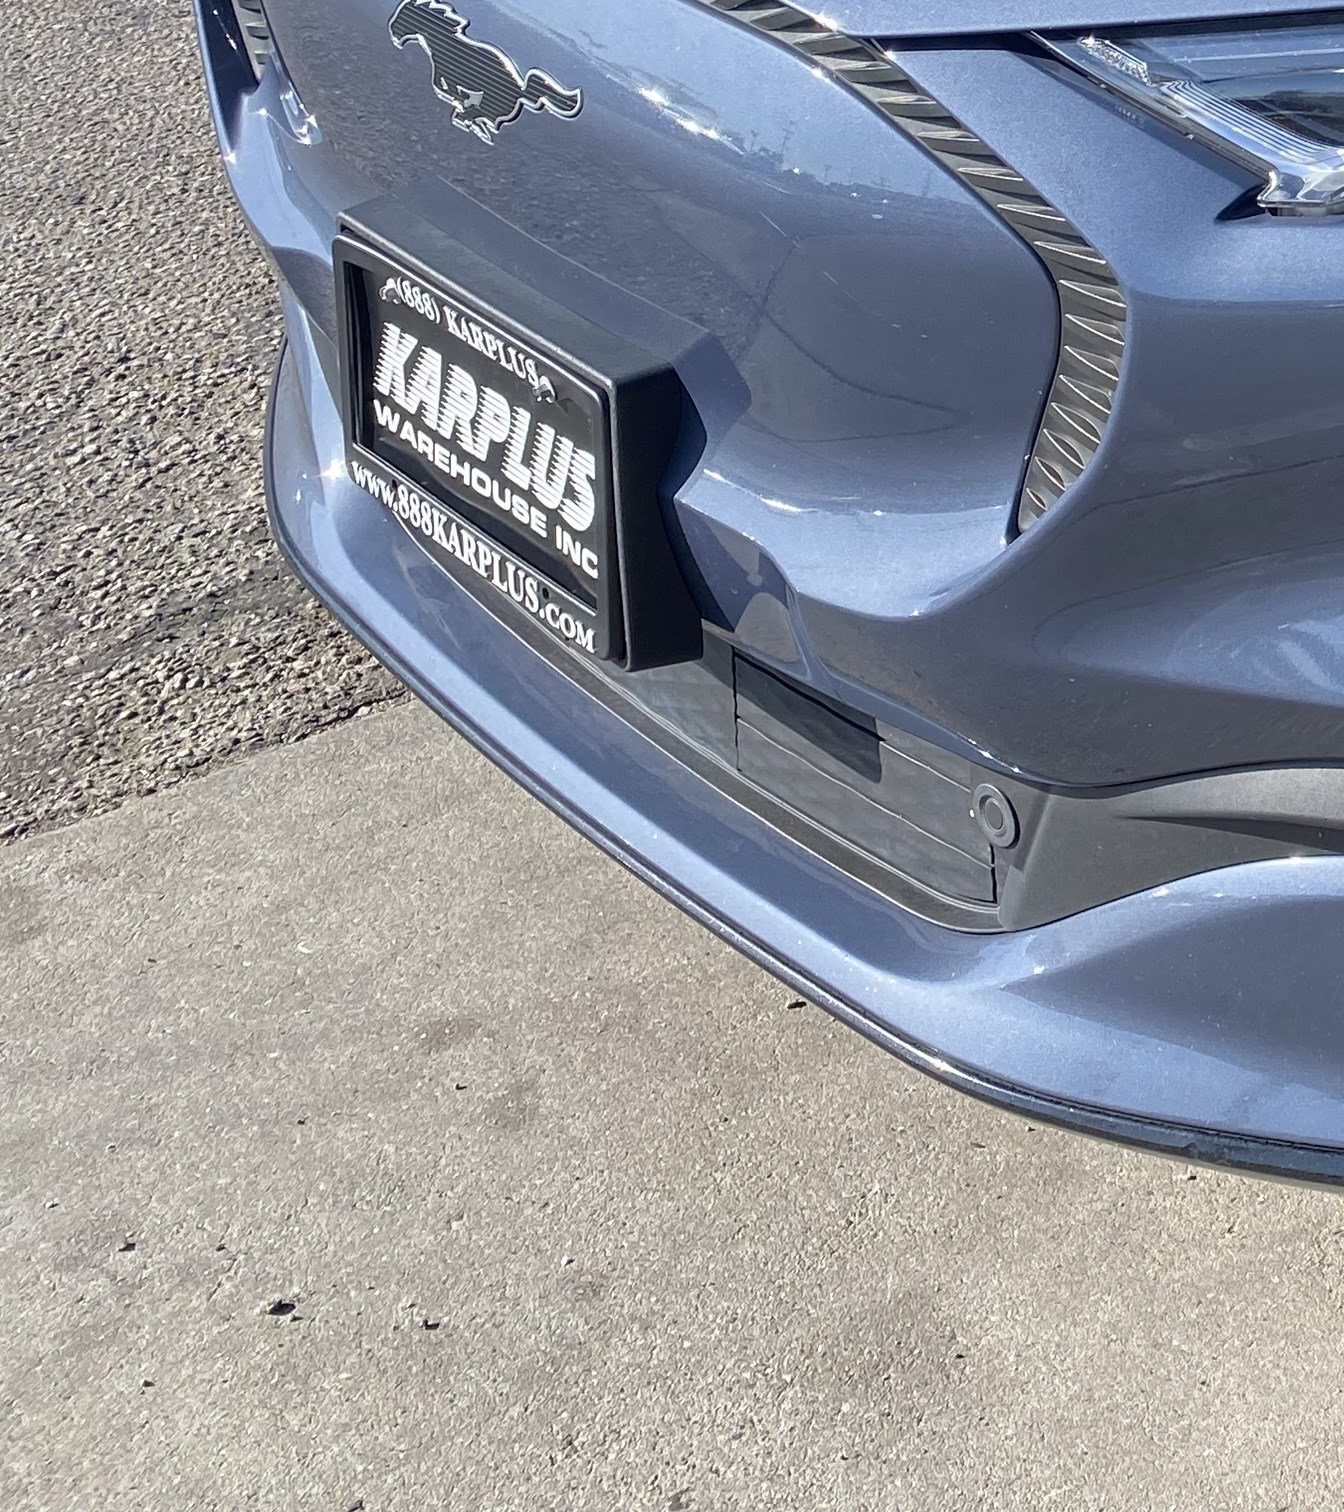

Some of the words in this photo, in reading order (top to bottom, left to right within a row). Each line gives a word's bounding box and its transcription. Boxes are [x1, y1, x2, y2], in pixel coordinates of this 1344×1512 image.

[396, 275, 441, 325] (888)
[443, 305, 540, 386] KARPLUS
[372, 322, 596, 533] KARPLUS
[373, 399, 548, 539] WAREHOUSE
[555, 525, 599, 580] INC
